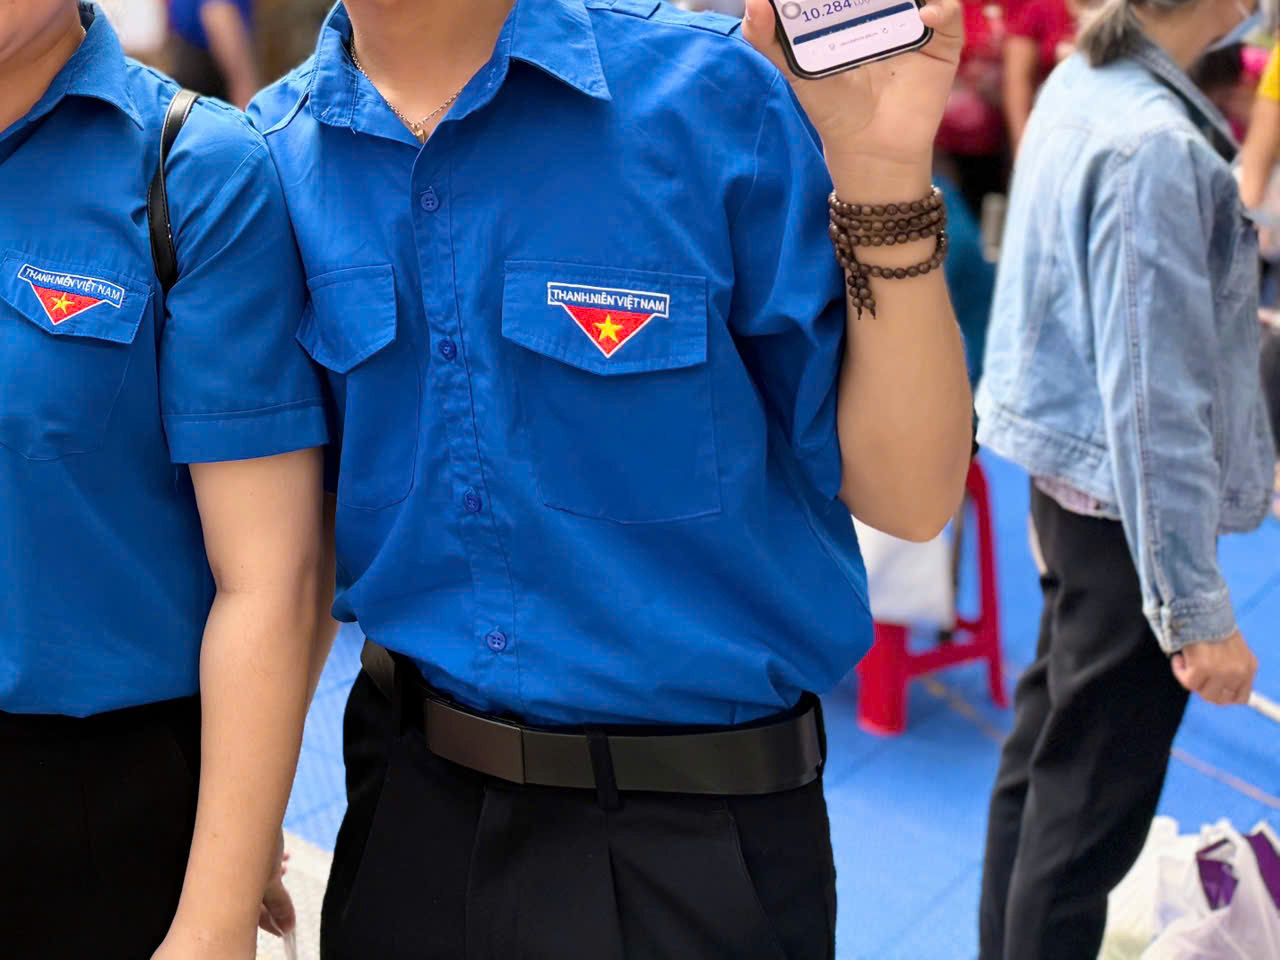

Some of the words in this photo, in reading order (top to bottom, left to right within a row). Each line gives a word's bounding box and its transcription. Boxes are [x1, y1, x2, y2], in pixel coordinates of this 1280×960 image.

[25, 268, 55, 284] THANH
[76, 279, 96, 293] VIỆT
[97, 284, 120, 301] NAM
[552, 289, 589, 304] THANH
[590, 292, 615, 306] NIÊN
[615, 294, 640, 310] VIỆT
[640, 298, 665, 312] NAM
